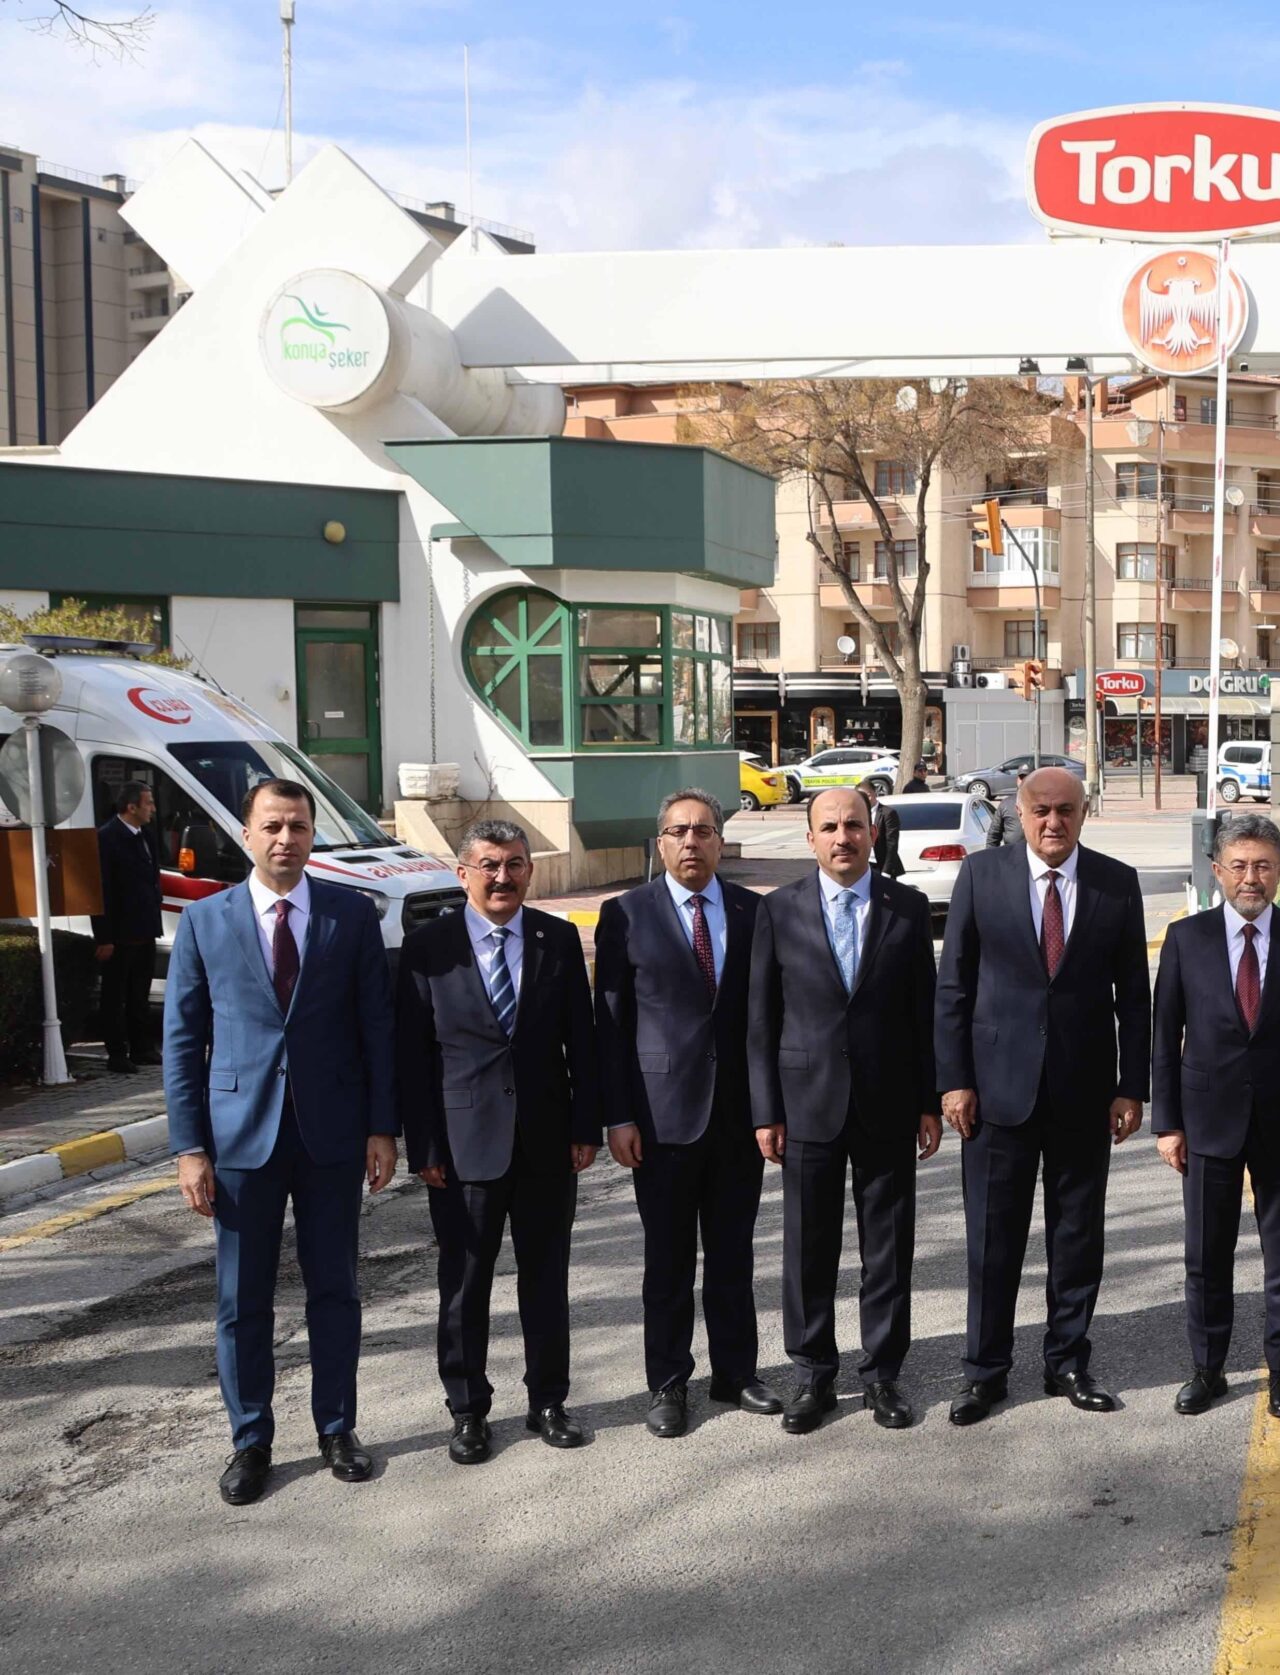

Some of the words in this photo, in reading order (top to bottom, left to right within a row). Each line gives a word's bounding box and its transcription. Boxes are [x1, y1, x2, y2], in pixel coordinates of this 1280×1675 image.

[284, 341, 326, 363] konya
[328, 348, 370, 370] şeker
[1101, 676, 1139, 690] Torku
